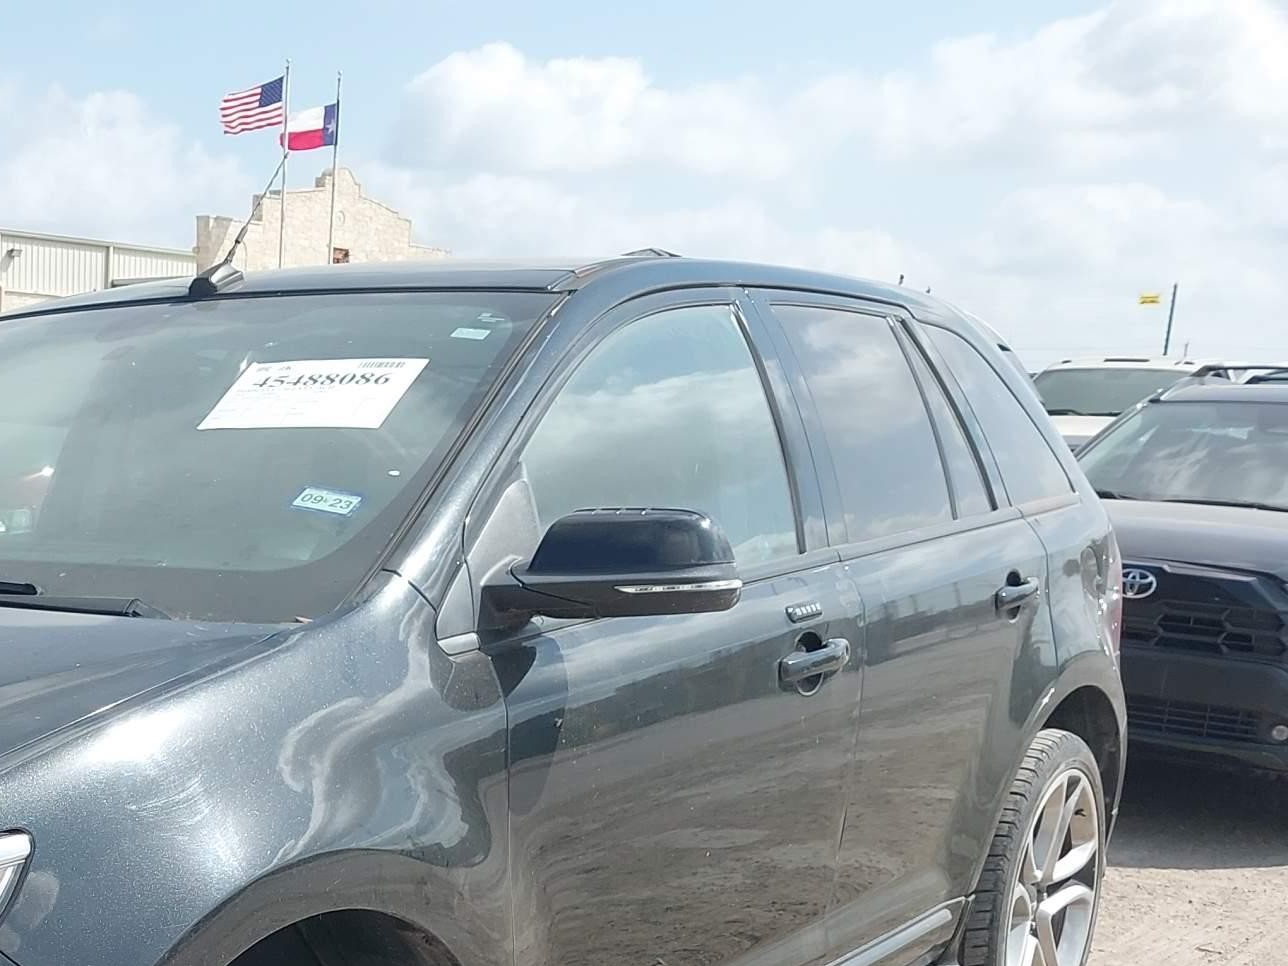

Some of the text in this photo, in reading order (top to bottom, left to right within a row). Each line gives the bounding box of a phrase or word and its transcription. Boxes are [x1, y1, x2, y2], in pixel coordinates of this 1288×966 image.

[253, 373, 393, 388] 45488086
[301, 494, 352, 509] 09 23
